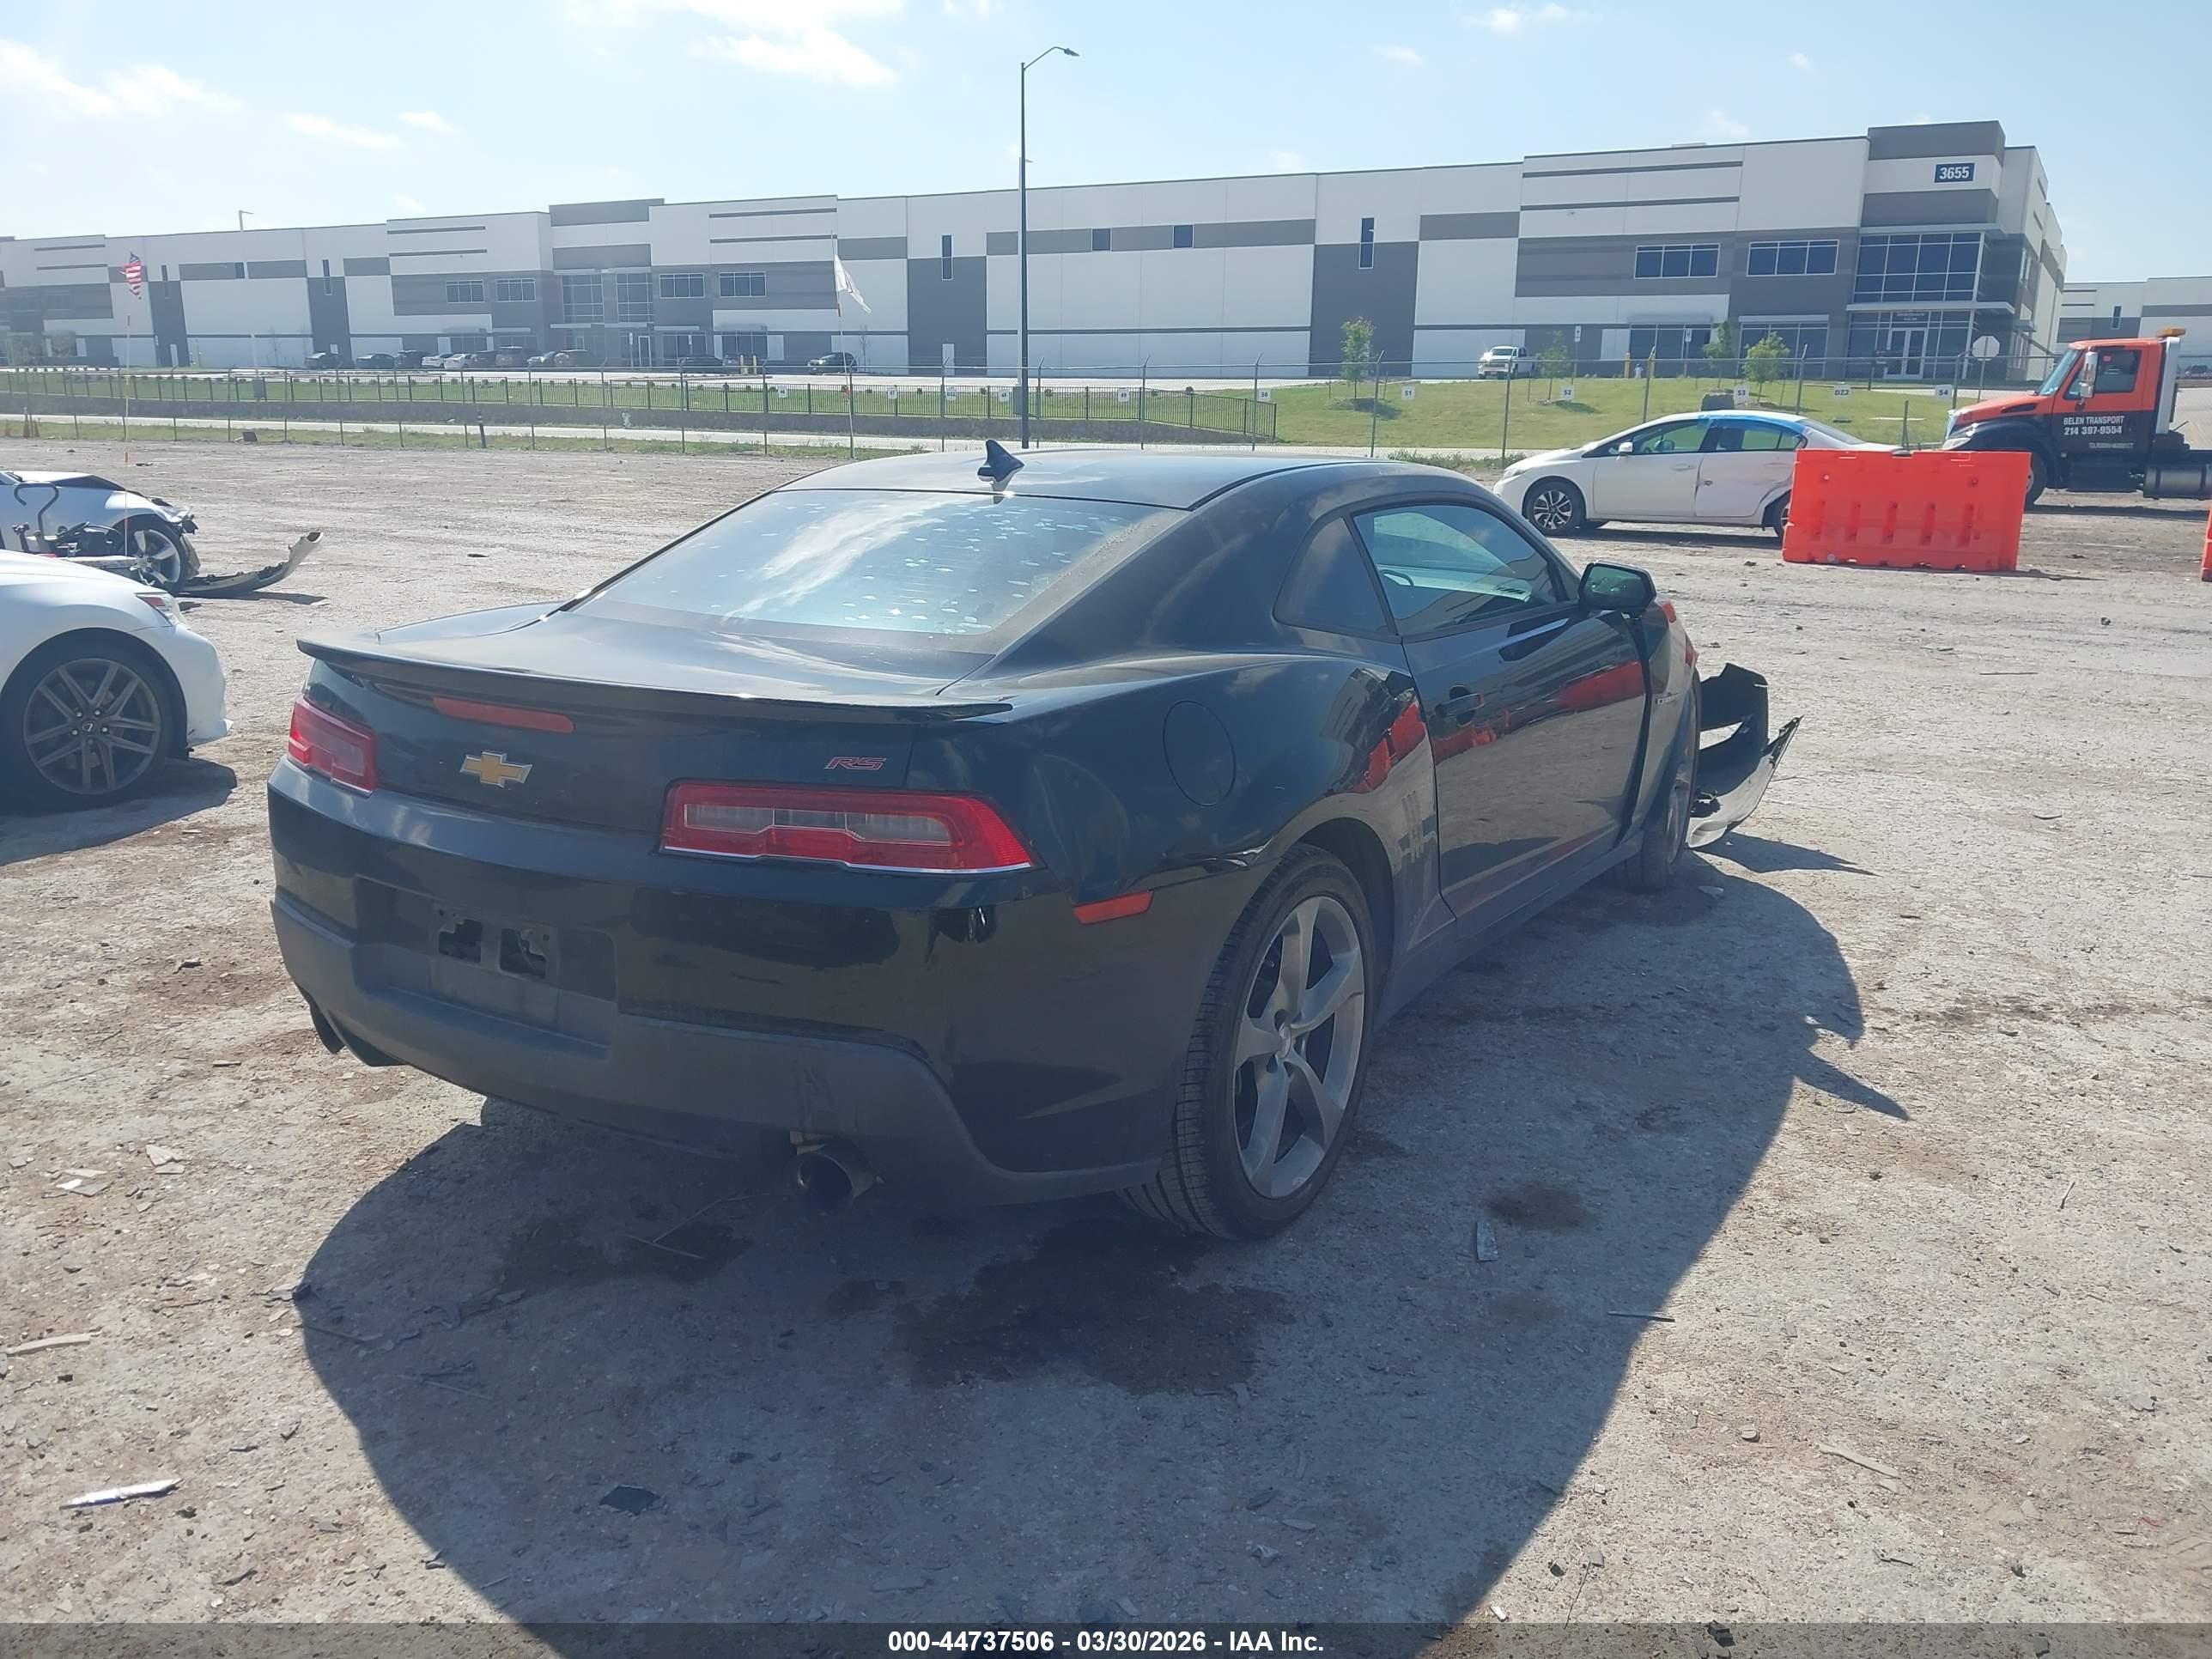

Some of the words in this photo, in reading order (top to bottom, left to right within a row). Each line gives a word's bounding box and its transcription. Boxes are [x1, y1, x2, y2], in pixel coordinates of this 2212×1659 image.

[1939, 167, 1970, 179] 3655
[2086, 416, 2124, 424] TRANSPORT
[2064, 427, 2078, 435] 214
[2081, 426, 2123, 434] 397-9554
[824, 757, 887, 769] RS
